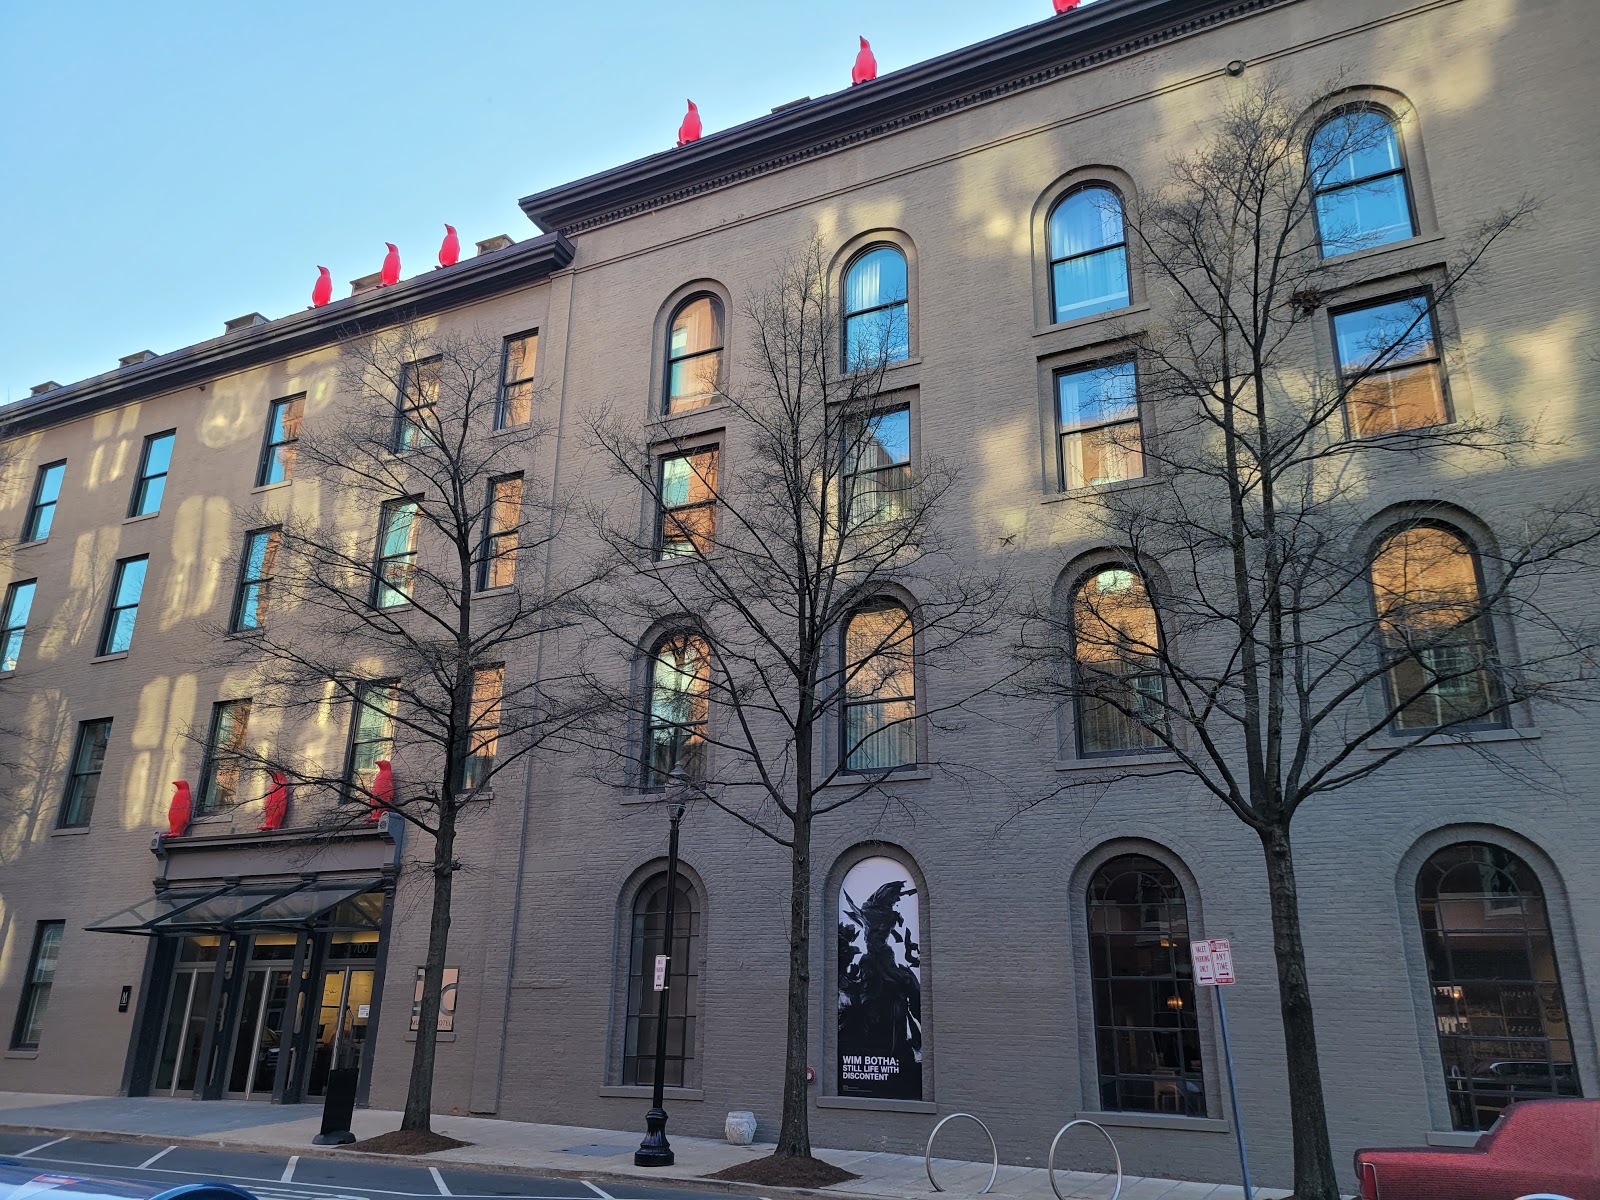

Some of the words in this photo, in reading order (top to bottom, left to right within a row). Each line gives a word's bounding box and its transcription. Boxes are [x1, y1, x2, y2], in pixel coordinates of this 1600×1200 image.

[1216, 962, 1229, 970] TIME
[843, 1056, 862, 1064] WIM
[865, 1056, 899, 1066] BOTHA:
[843, 1072, 889, 1080] DISCONTENT
